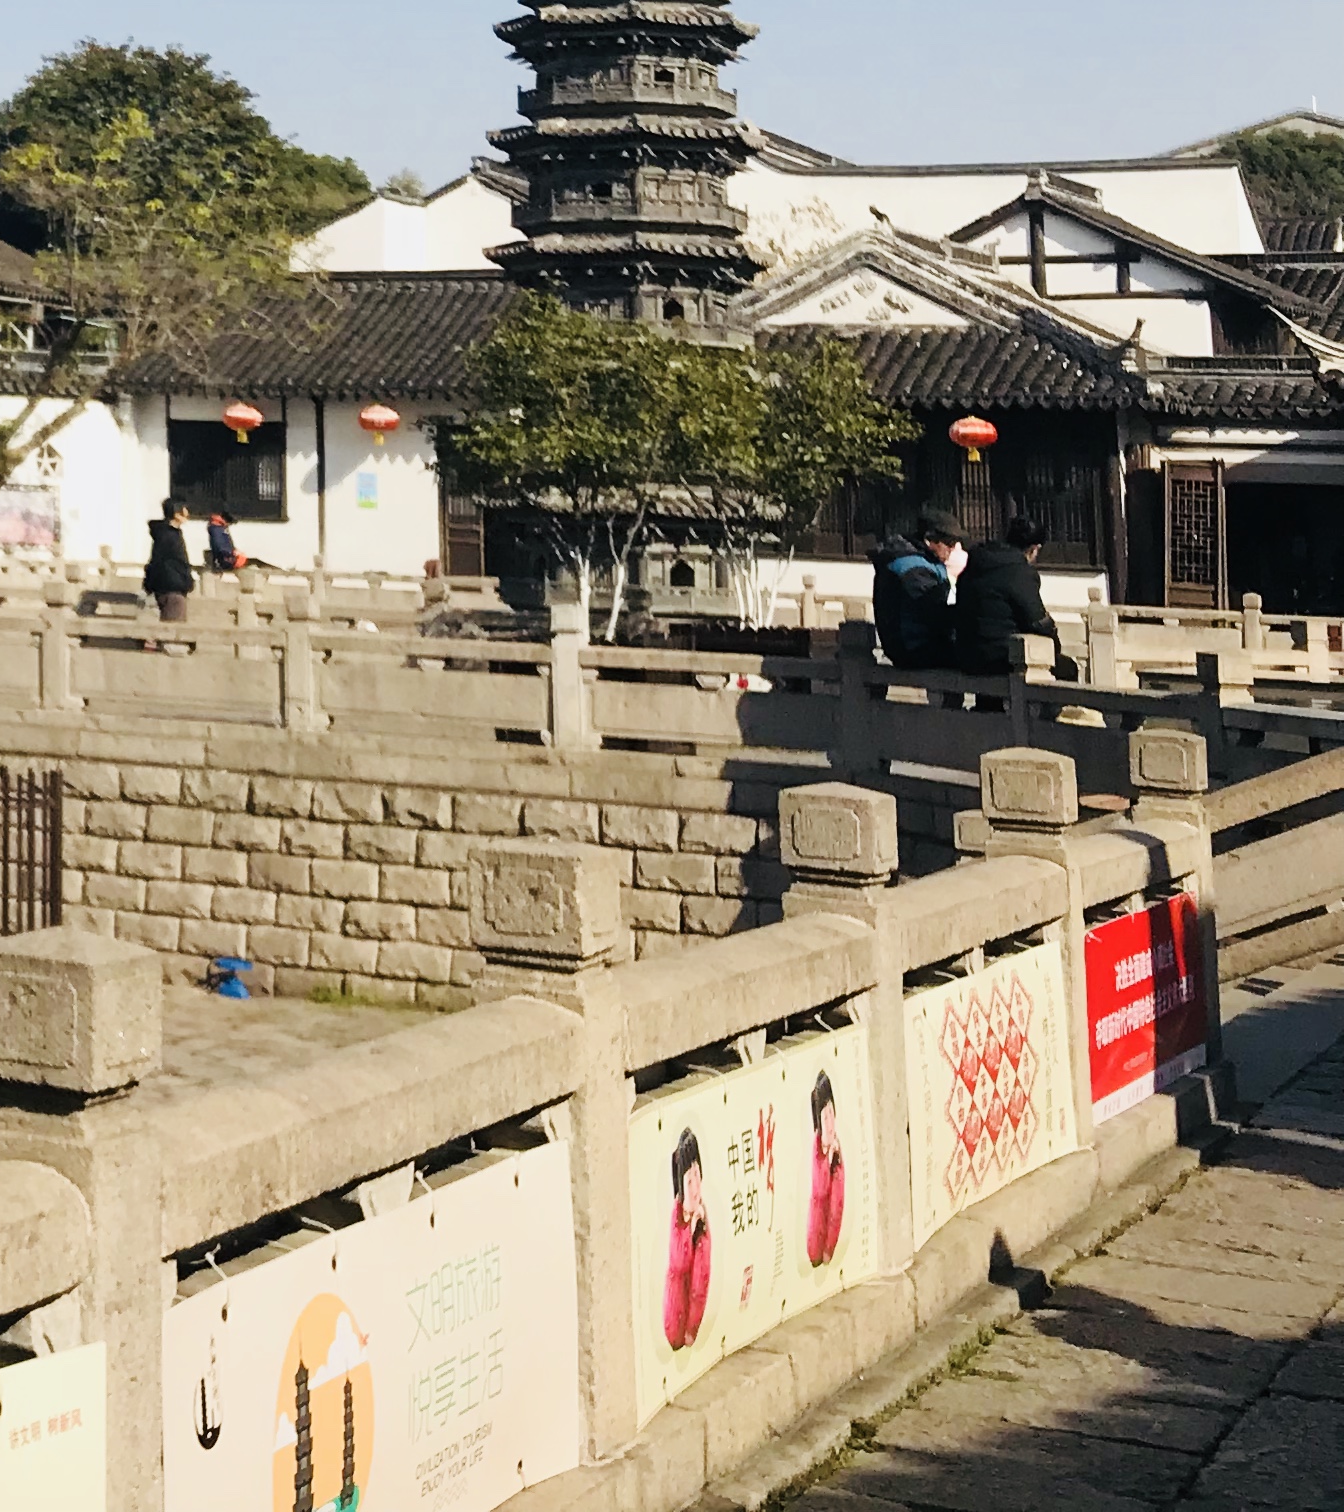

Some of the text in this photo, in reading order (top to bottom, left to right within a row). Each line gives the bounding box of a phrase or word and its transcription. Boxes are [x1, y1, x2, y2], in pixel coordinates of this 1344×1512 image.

[730, 1180, 760, 1237] 我的
[405, 1242, 502, 1354] 文明旅游
[407, 1328, 505, 1445] 悦享生活
[421, 1445, 484, 1498] ENJOY YOUR LIFE
